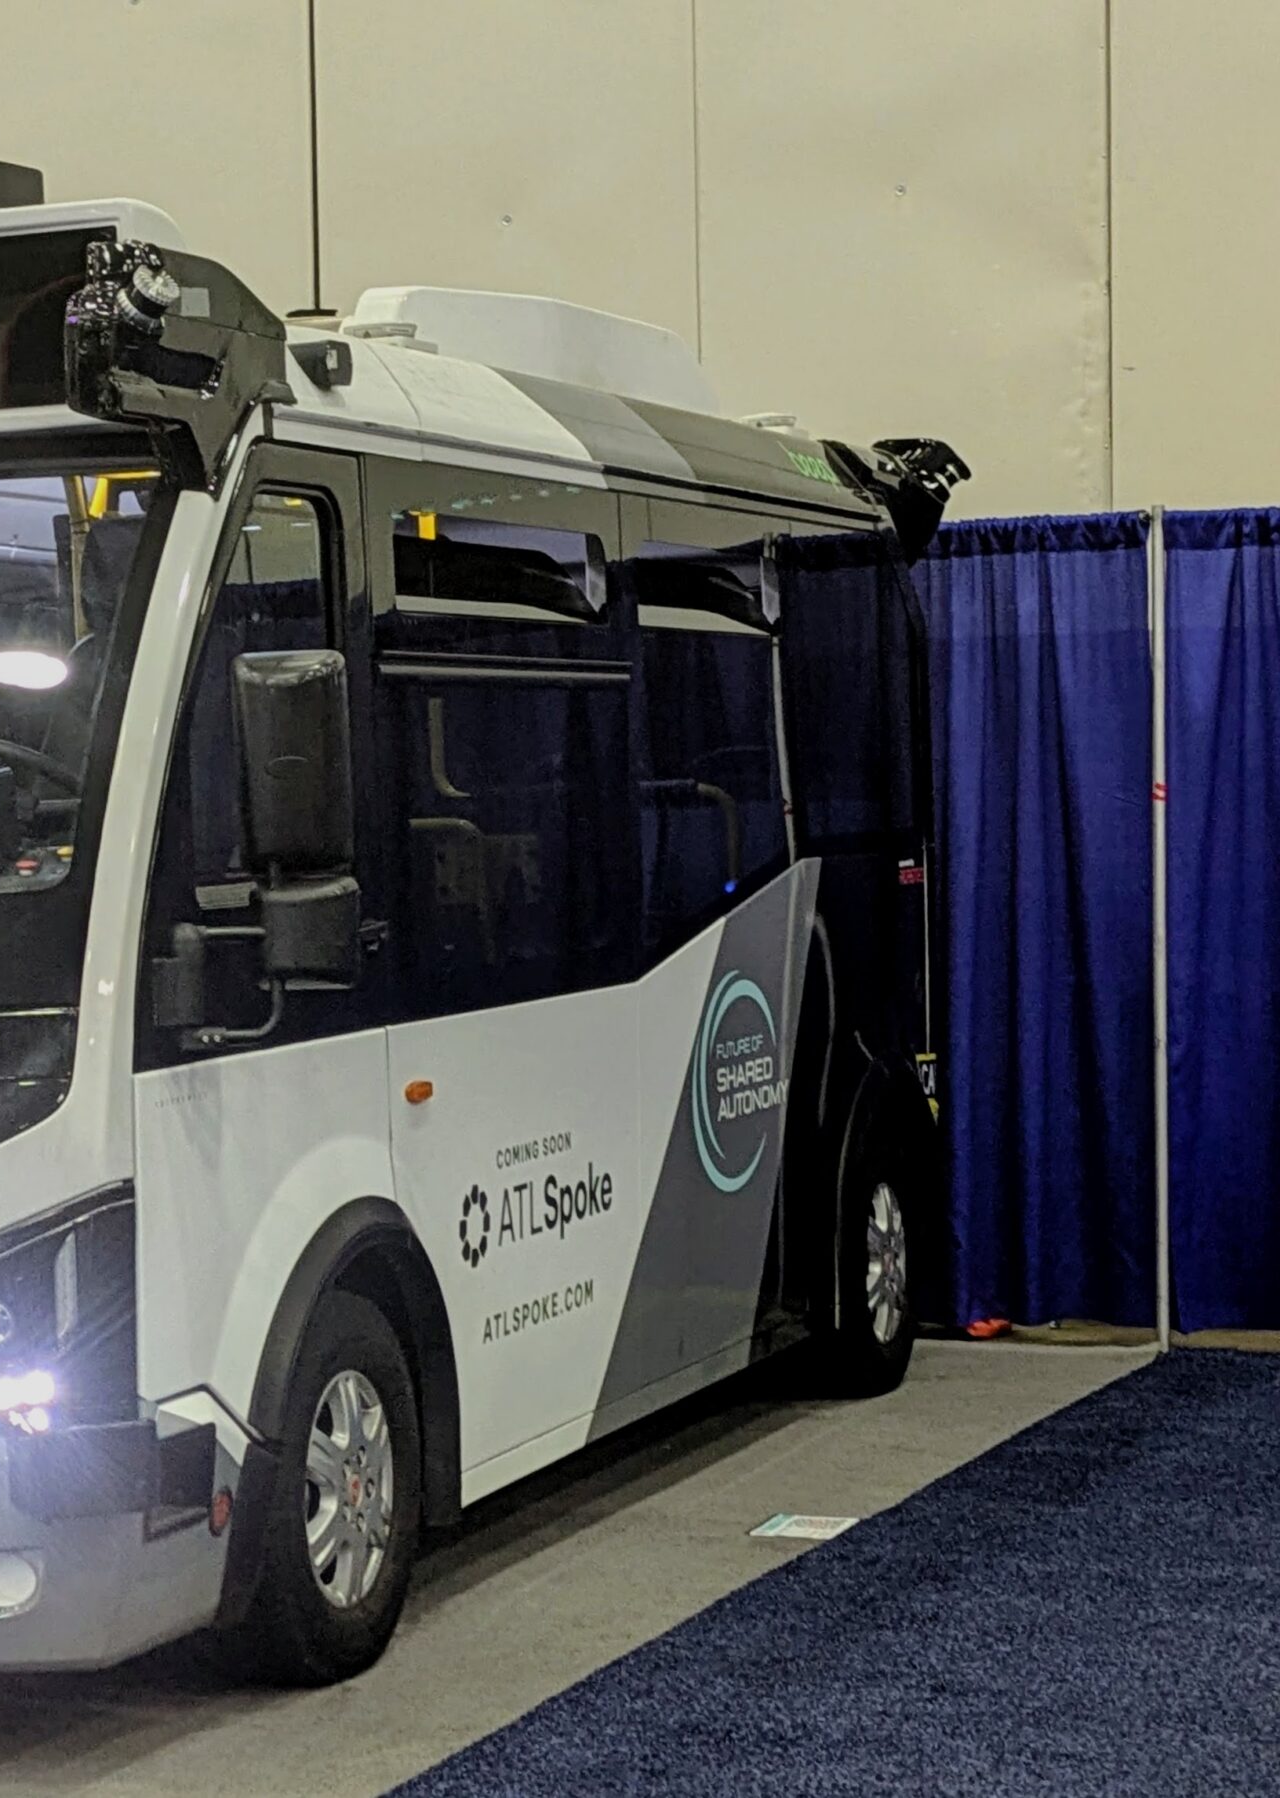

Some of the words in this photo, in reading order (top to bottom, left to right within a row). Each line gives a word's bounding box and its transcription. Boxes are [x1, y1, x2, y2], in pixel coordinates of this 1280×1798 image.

[716, 1037, 751, 1059] FUTURE
[751, 1034, 764, 1052] OF
[716, 1056, 773, 1093] SHARED
[717, 1079, 789, 1122] AUTONOMY
[496, 1140, 540, 1169] COMING
[542, 1132, 572, 1157] SOON
[497, 1161, 613, 1247] ATLSpoke
[482, 1279, 594, 1344] ATLSPOKE.COM
